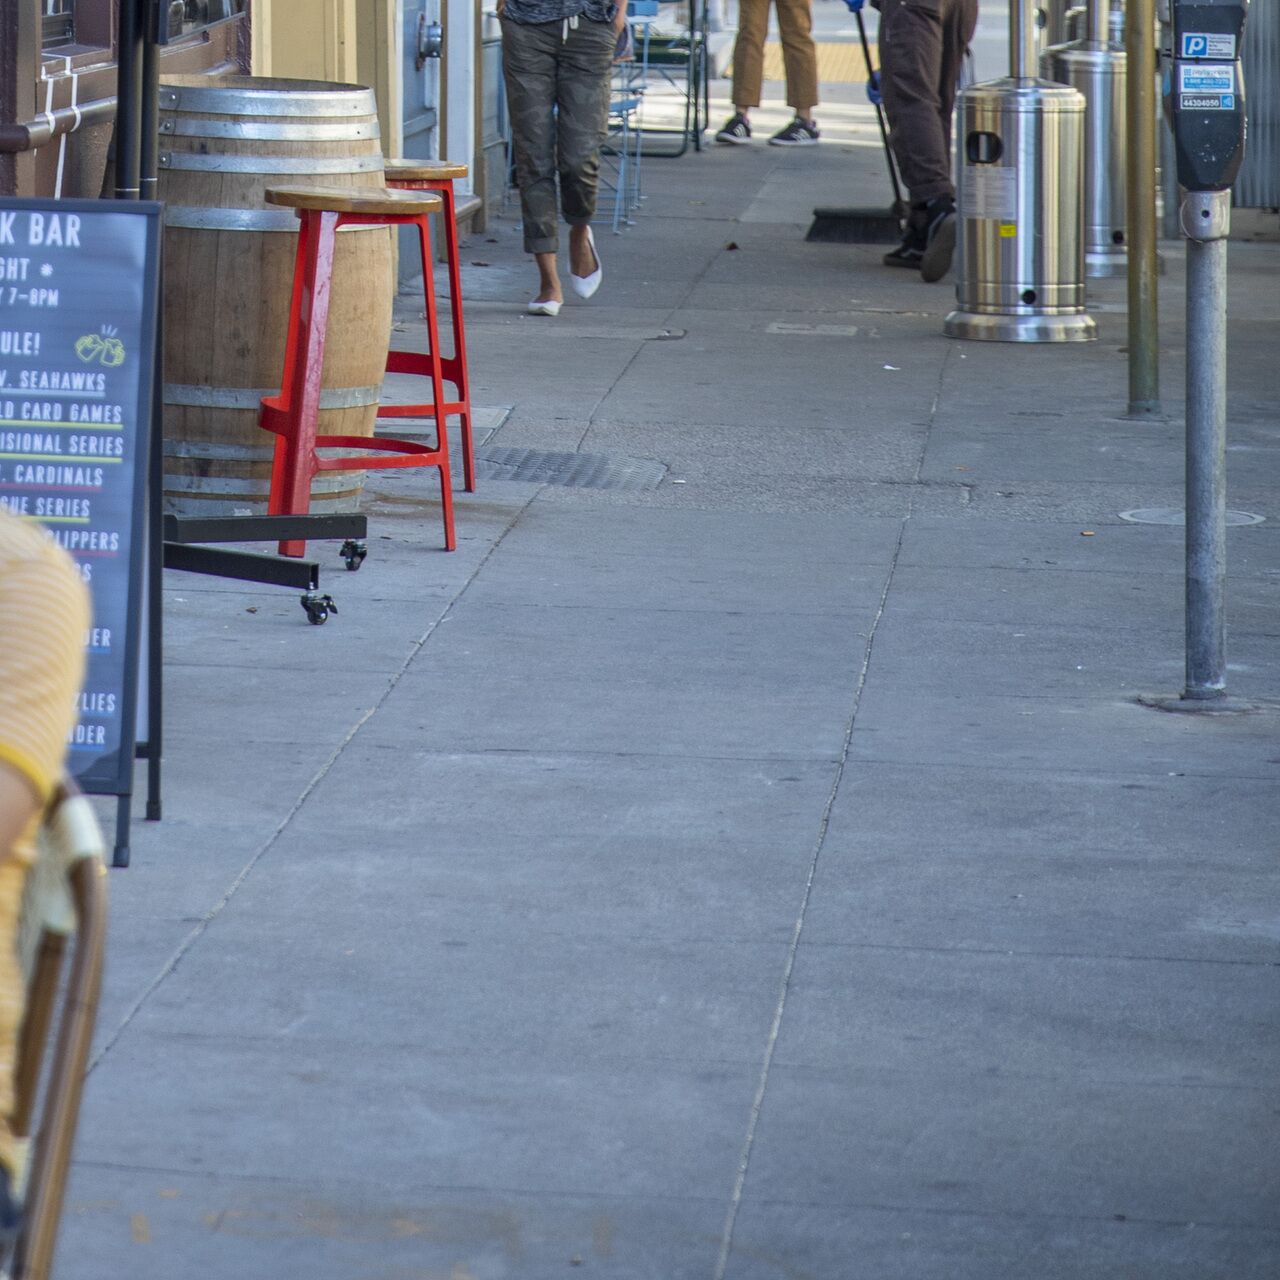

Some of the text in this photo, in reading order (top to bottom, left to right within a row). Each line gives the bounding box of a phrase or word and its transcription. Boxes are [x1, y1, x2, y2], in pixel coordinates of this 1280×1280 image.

[28, 211, 81, 248] BAR
[20, 369, 107, 392] SEAHAWKS
[21, 400, 63, 422] CARD
[69, 403, 123, 424] GAMES
[69, 434, 124, 456] SERIES
[15, 463, 104, 487] CARDINALS
[36, 495, 91, 518] SERIES
